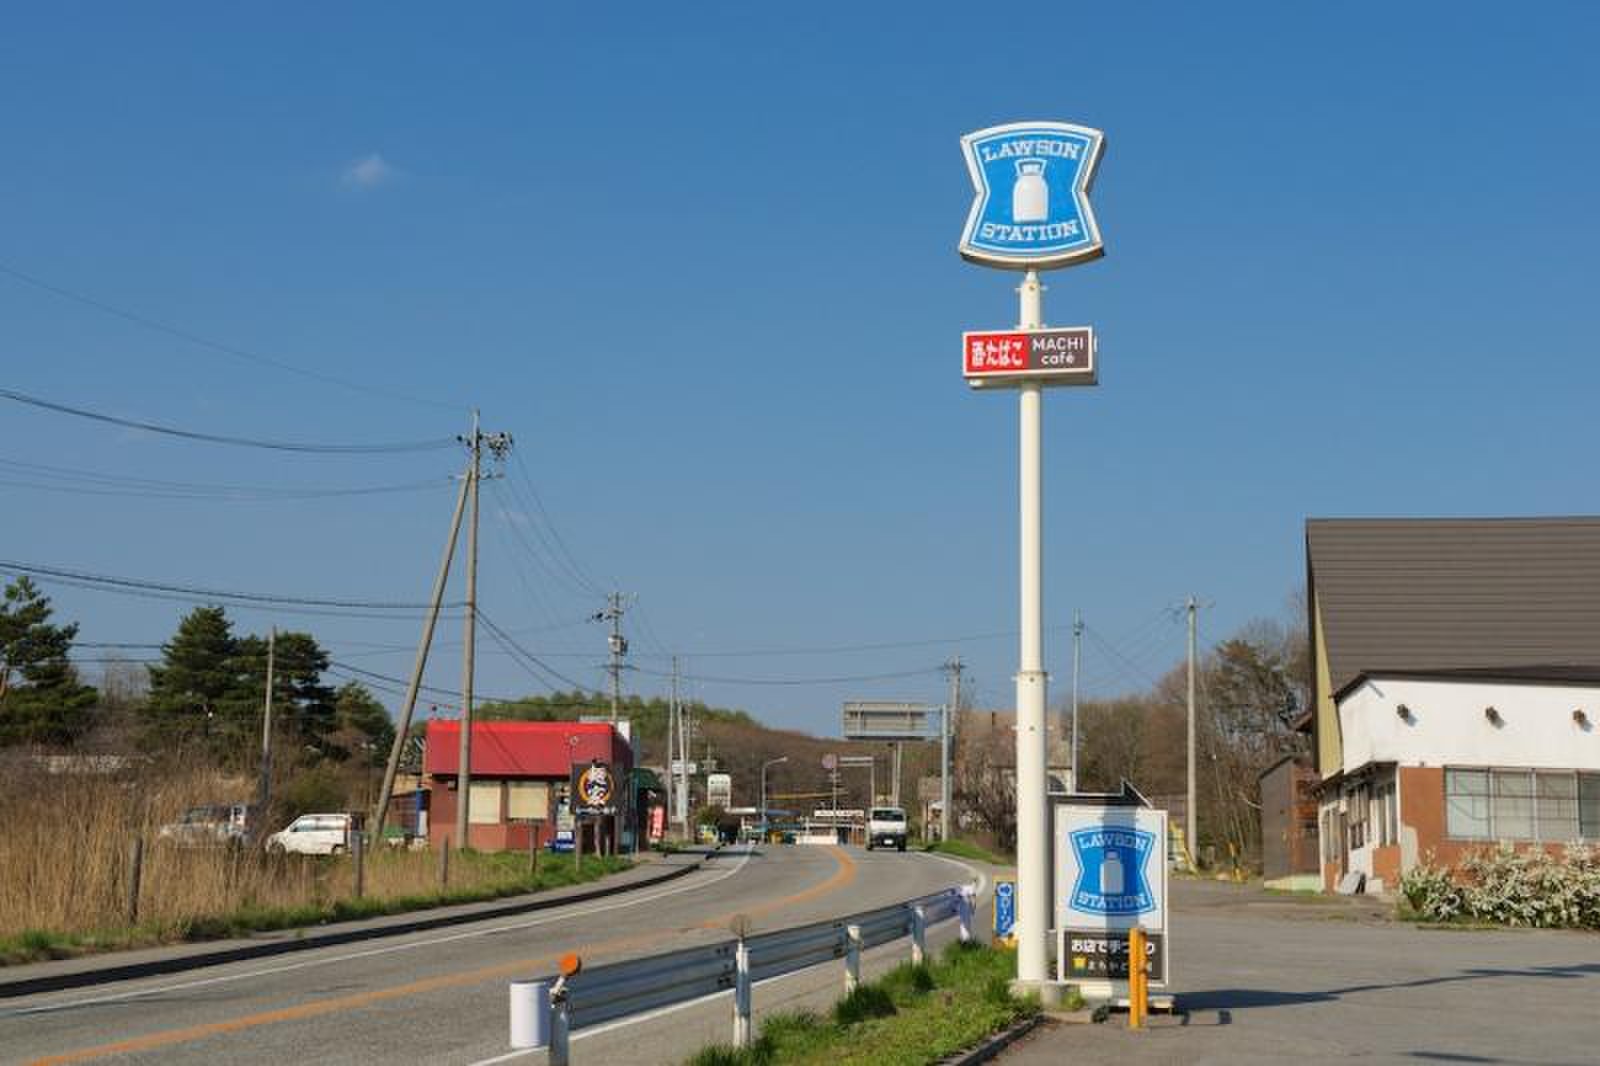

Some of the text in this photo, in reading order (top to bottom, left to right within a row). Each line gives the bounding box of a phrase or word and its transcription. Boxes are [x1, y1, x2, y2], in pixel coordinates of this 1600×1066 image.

[981, 140, 1080, 162] LAWSON
[979, 218, 1080, 241] STATION
[1032, 337, 1083, 351] MACHI
[1079, 832, 1148, 849] LAWSON
[1078, 891, 1148, 910] STATION
